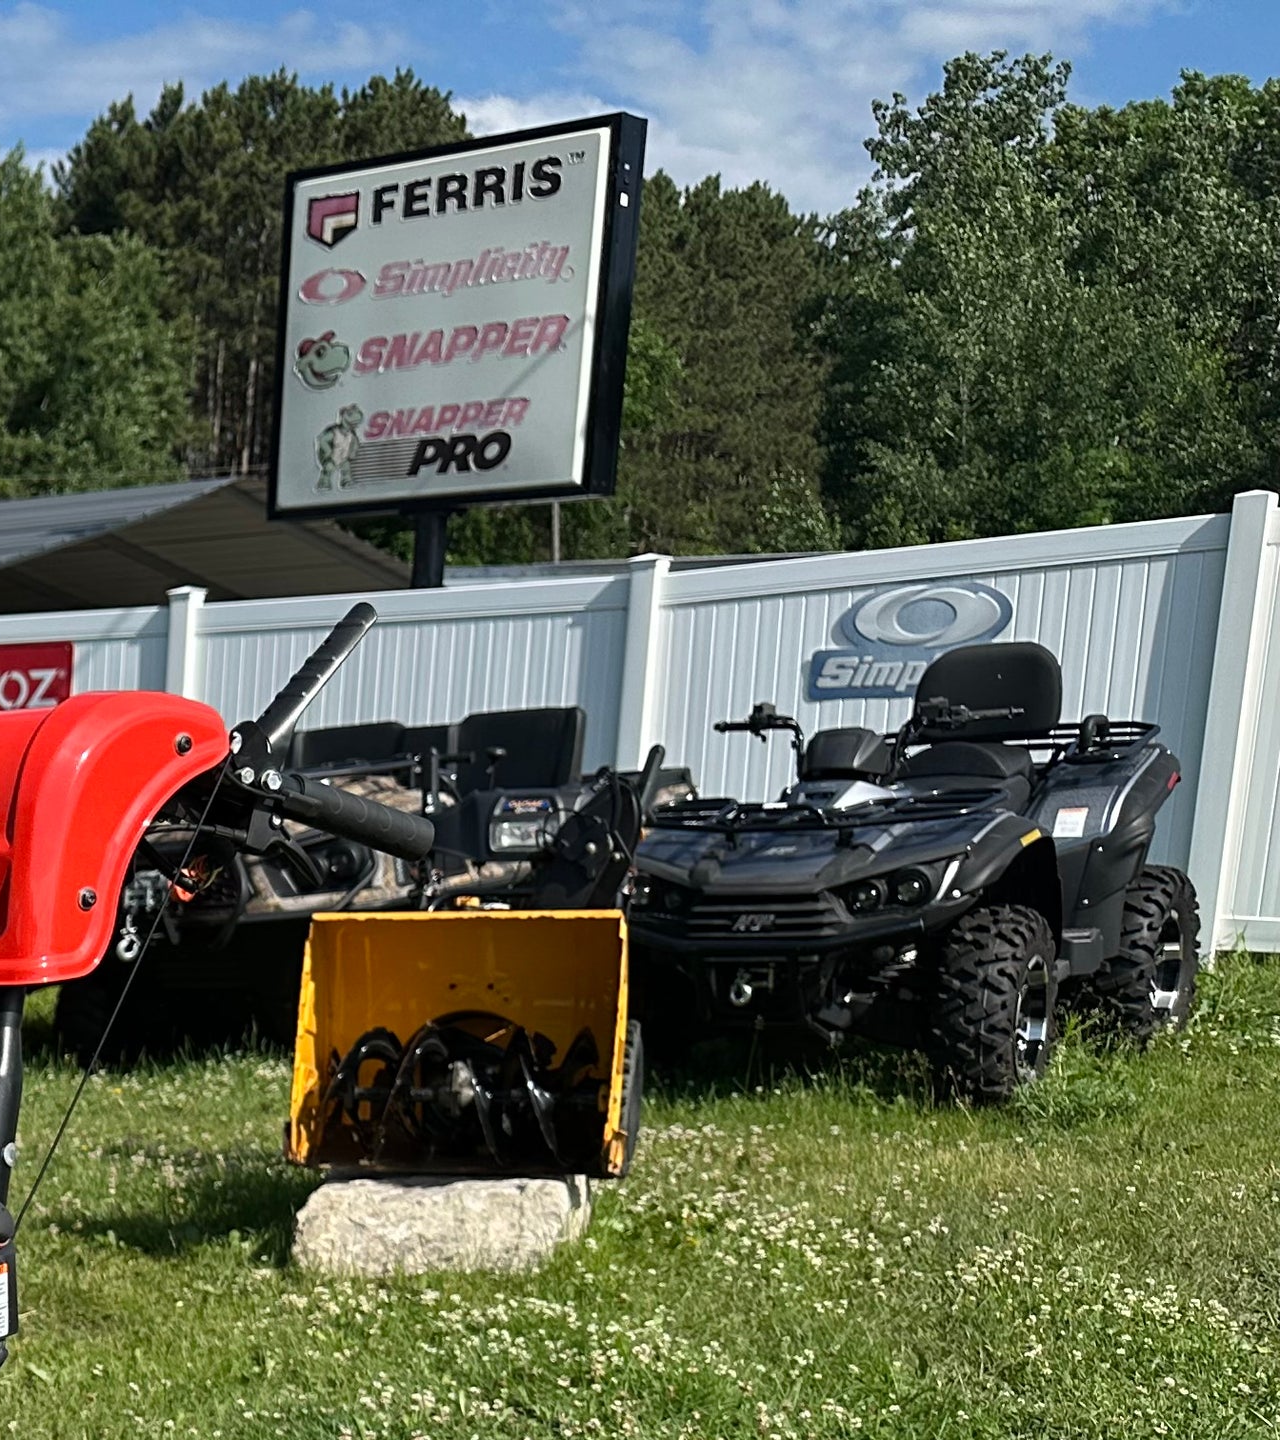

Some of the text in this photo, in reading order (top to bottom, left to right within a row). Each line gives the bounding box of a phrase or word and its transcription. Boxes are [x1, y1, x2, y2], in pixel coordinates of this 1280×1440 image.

[371, 155, 563, 226] FERRIS
[373, 241, 570, 297] Simplicity
[353, 314, 570, 374] SNAPPER
[364, 397, 531, 440] SNAPPER
[406, 431, 512, 477] PRO
[815, 655, 928, 692] Simp
